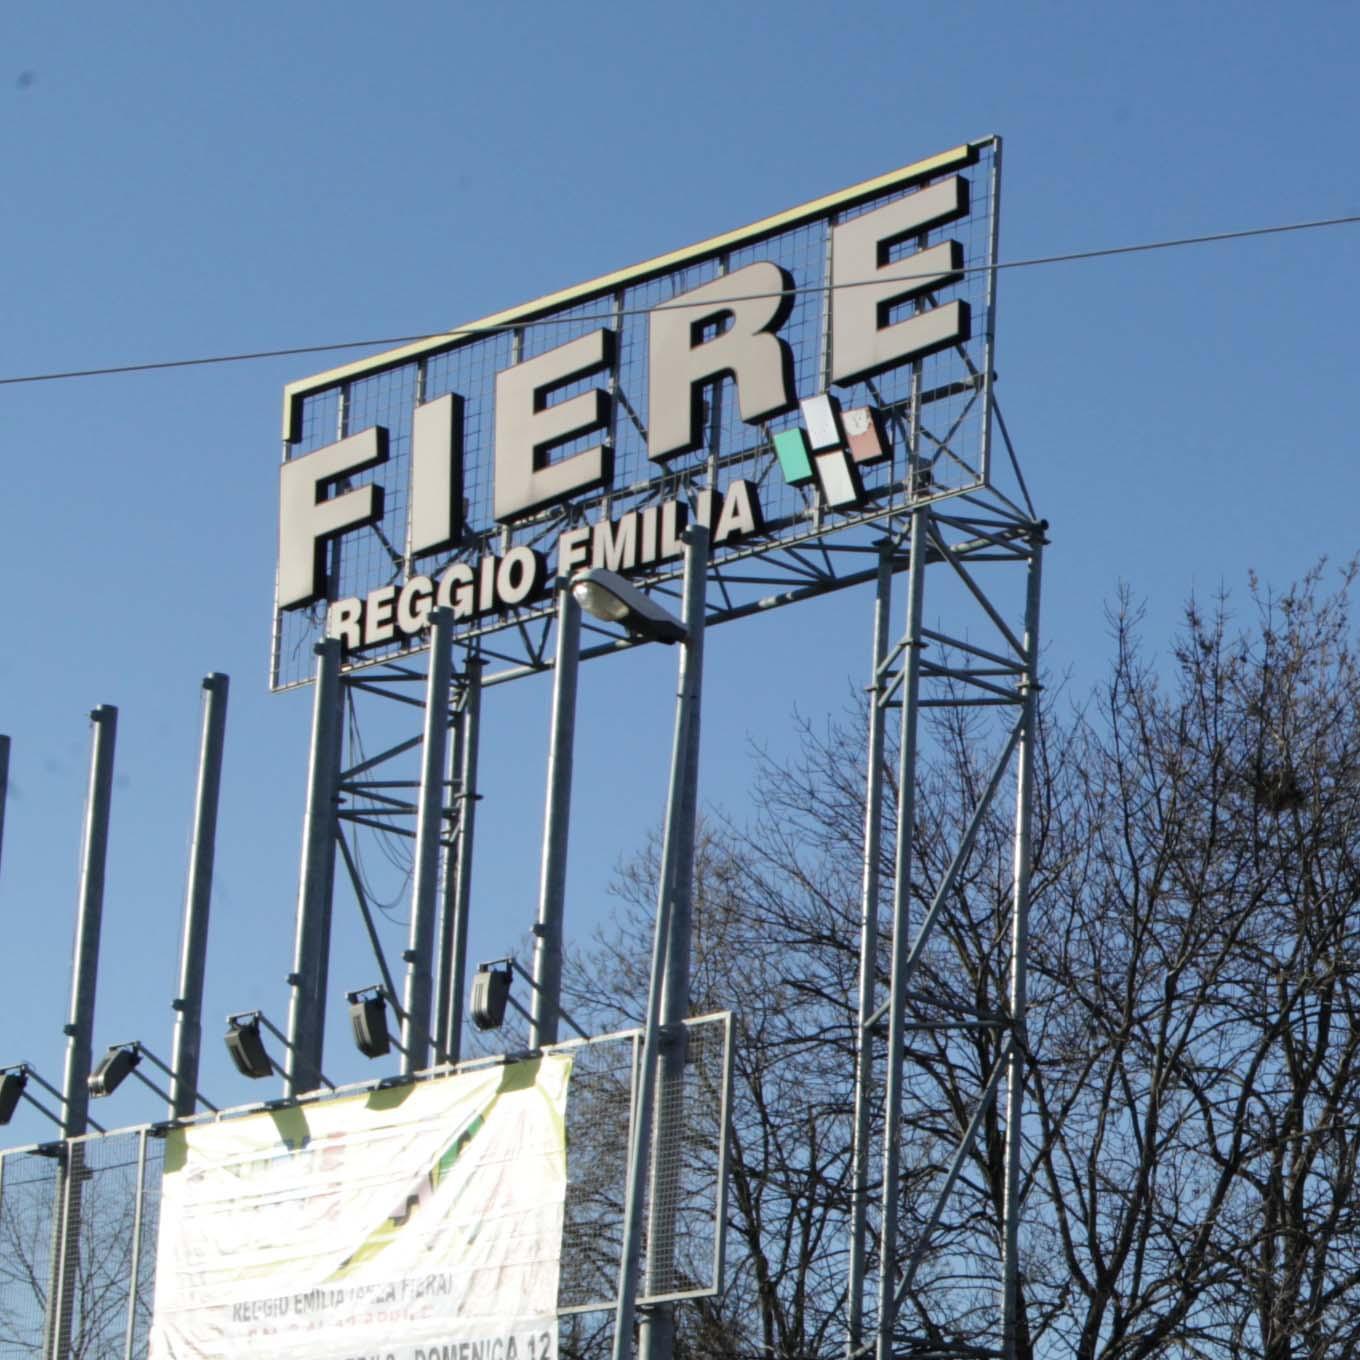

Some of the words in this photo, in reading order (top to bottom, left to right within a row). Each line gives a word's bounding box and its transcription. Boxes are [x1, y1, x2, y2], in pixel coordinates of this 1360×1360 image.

[279, 175, 970, 610] FIERE
[327, 546, 541, 651] REGGIO
[558, 480, 759, 577] EMILIA
